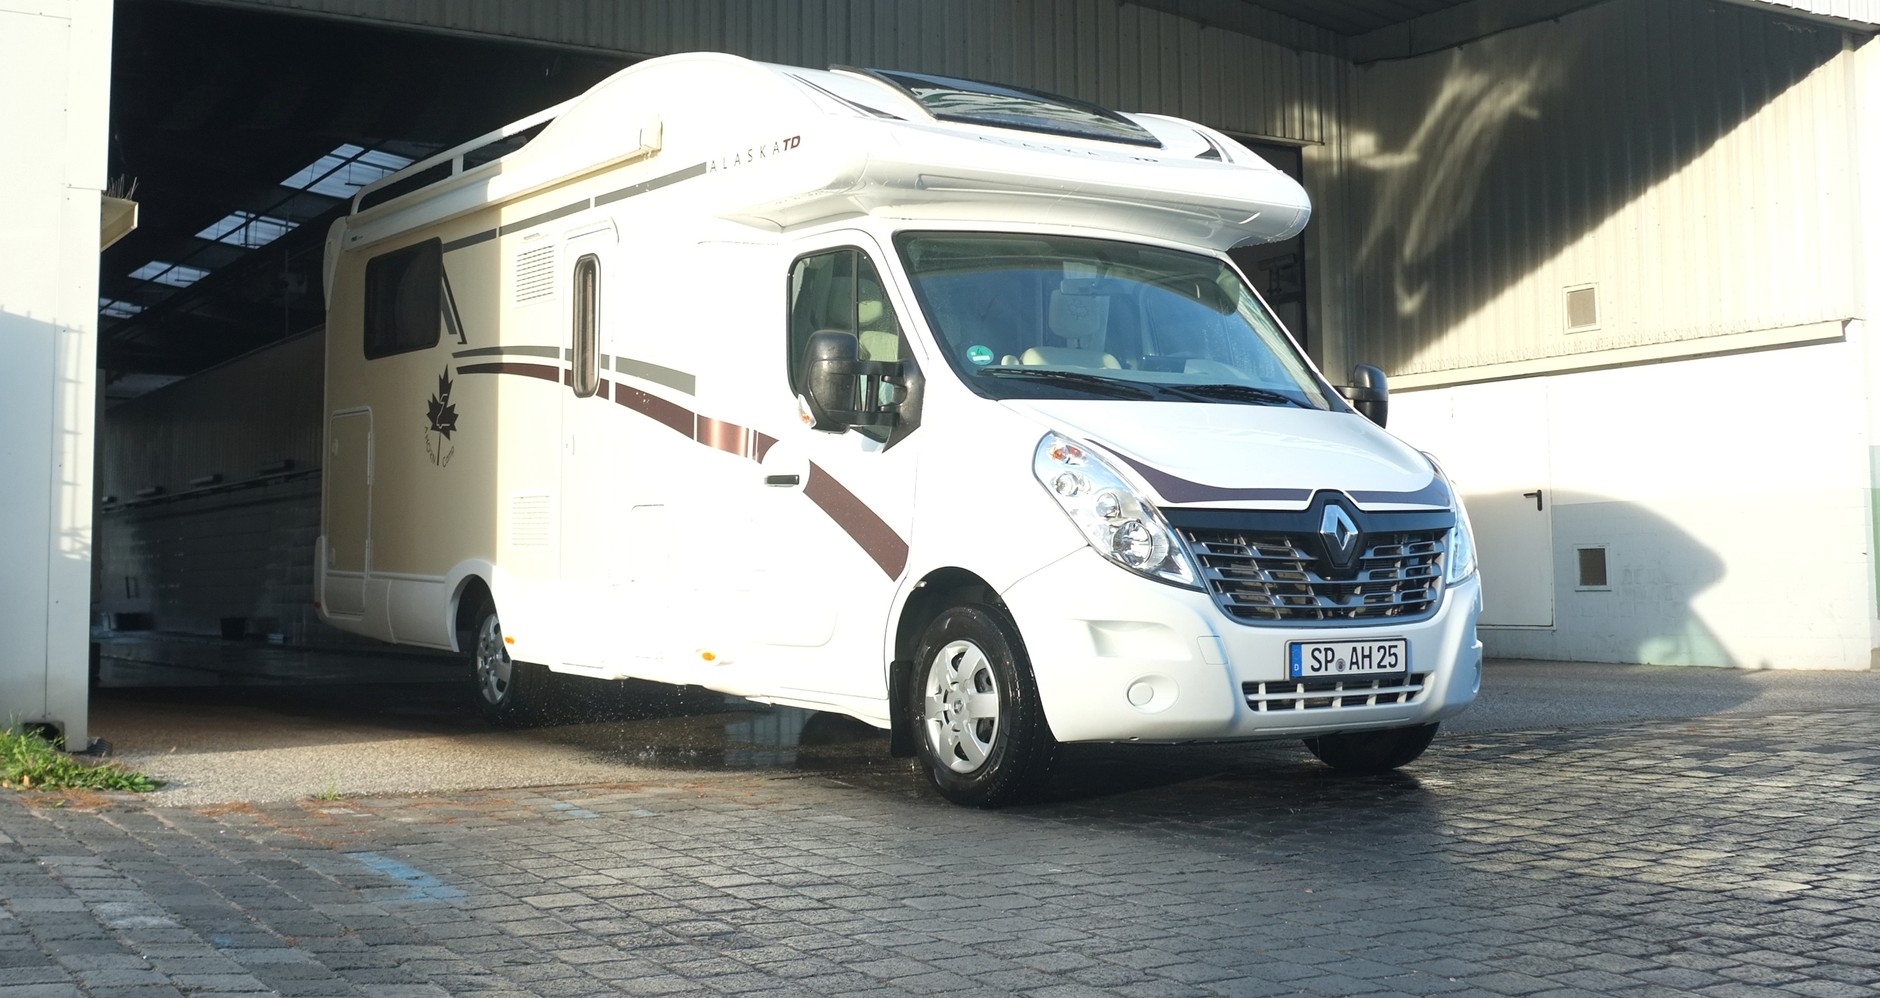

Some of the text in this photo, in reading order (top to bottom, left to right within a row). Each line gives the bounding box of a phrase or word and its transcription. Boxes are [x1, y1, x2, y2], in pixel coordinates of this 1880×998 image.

[709, 135, 801, 173] ALASKA TD
[1310, 647, 1335, 672] SP
[1349, 646, 1372, 670] AH
[1377, 645, 1398, 668] 25
